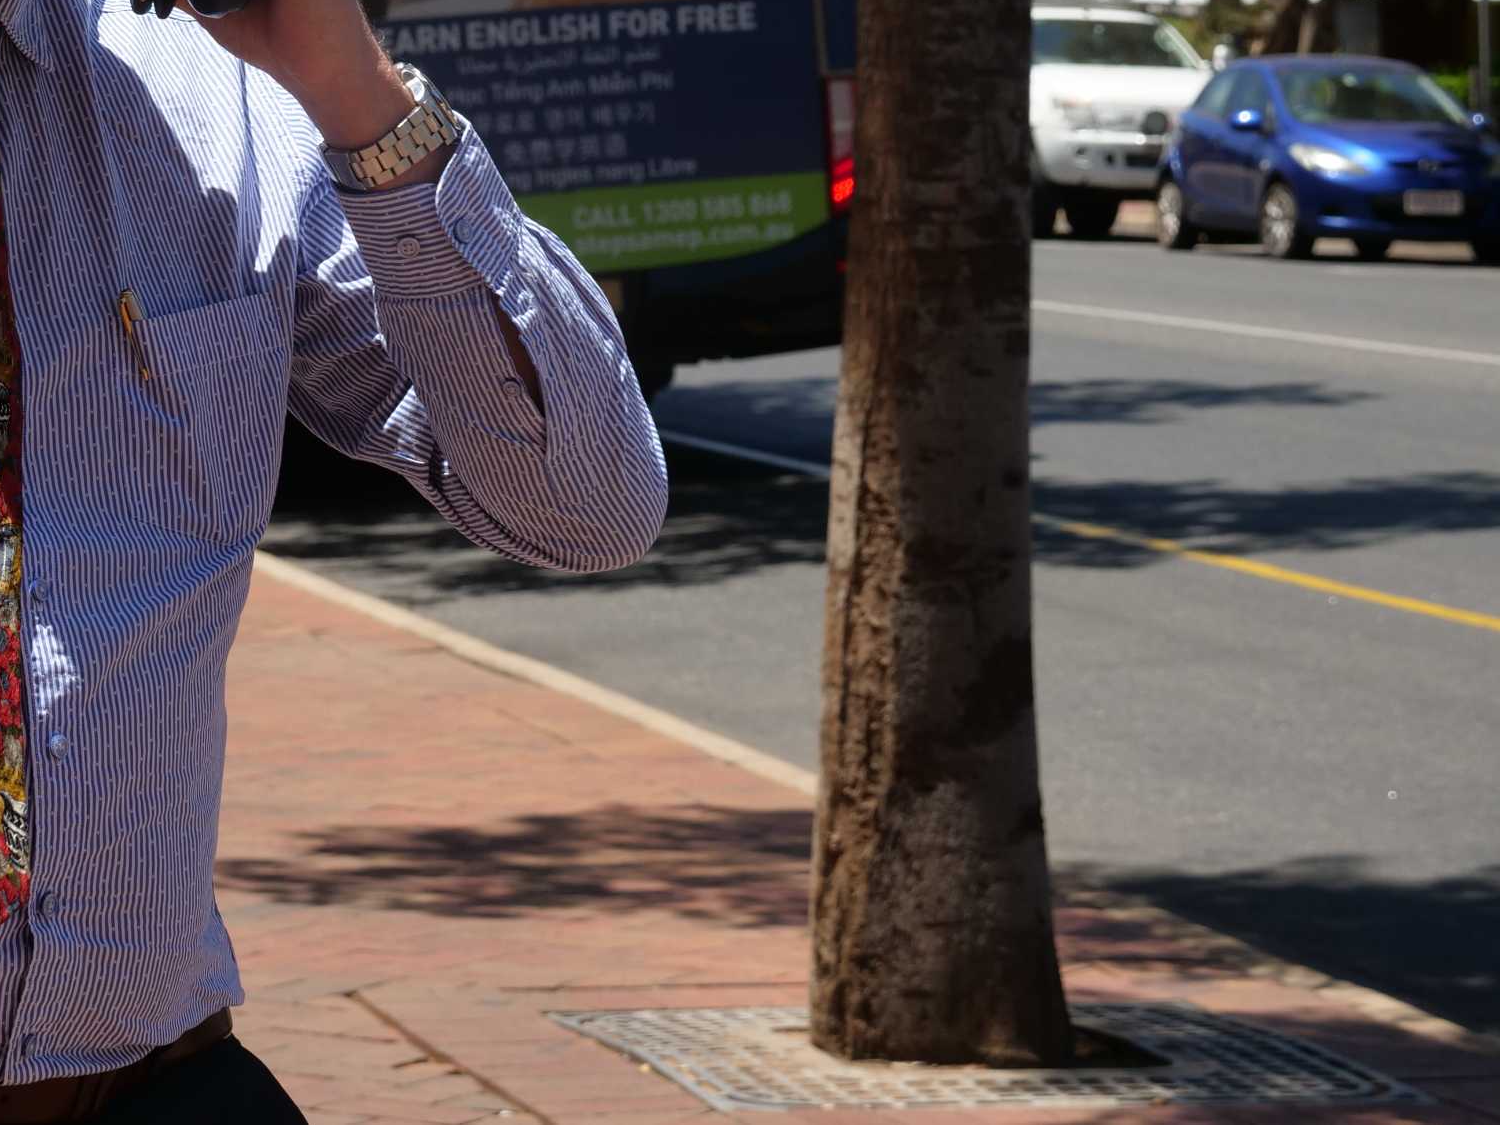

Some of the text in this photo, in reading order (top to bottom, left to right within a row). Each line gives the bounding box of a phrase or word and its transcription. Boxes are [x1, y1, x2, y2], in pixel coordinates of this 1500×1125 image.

[383, 1, 758, 55] EARN ENGLISH FOR FREE
[573, 203, 636, 229] CALL
